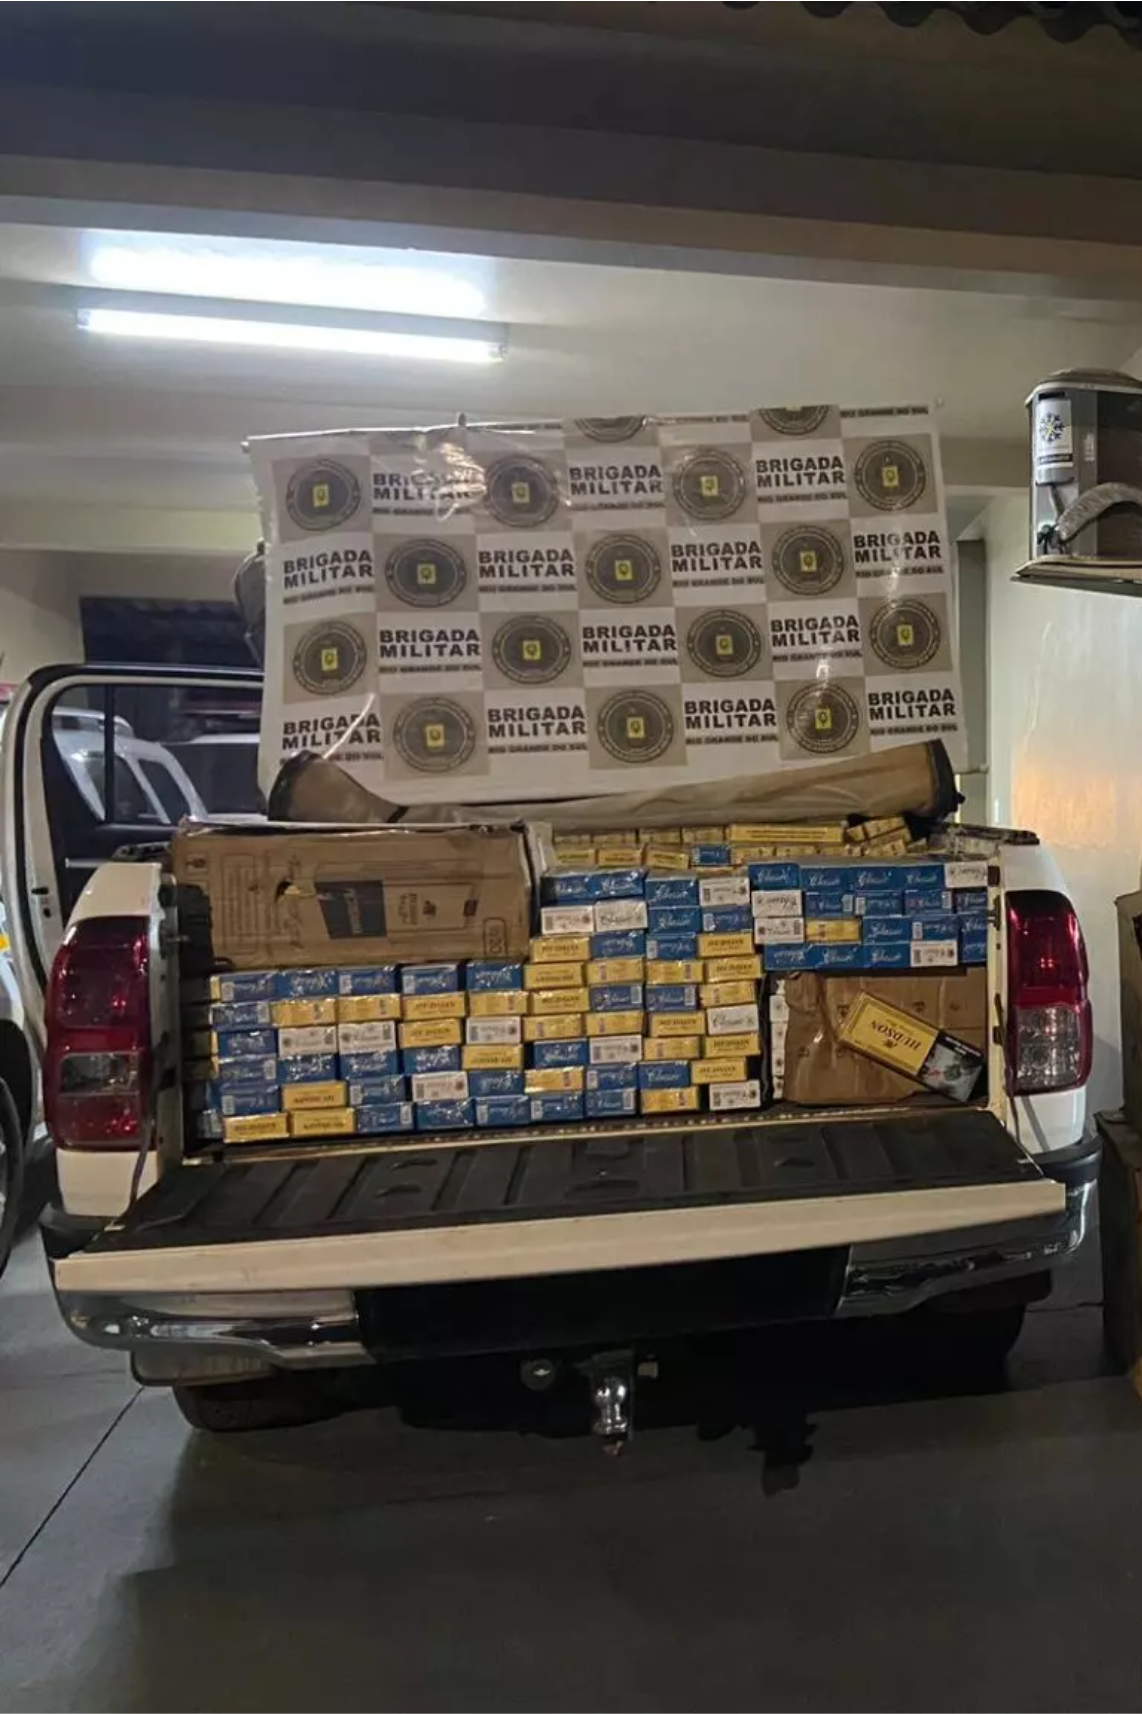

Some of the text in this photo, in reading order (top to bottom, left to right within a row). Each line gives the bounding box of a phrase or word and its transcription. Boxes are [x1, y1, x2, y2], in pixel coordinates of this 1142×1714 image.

[569, 464, 661, 480] BRIGADA
[756, 456, 844, 473] BRIGADA
[571, 479, 663, 495] MILITAR
[757, 471, 846, 488] MILITAR
[854, 530, 941, 549] BRIGADA
[479, 548, 574, 564] BRIGADA
[671, 541, 762, 558] BRIGADA
[284, 549, 372, 574] BRIGADA
[672, 555, 763, 573] MILITAR
[284, 564, 373, 590] MILITAR
[479, 564, 575, 579] MILITAR
[583, 624, 676, 639] BRIGADA
[771, 614, 859, 633] BRIGADA
[379, 629, 480, 643] BRIGADA
[772, 629, 860, 647] MILITAR
[379, 643, 480, 659] MILITAR
[583, 638, 677, 653] MILITAR
[868, 688, 955, 706] BRIGADA
[488, 705, 585, 723] BRIGADA
[684, 698, 775, 715] BRIGADA
[869, 703, 956, 721] MILITAR
[283, 713, 381, 735] BRIGADA
[488, 721, 587, 738] MILITAR
[685, 712, 776, 730] MILITAR
[282, 729, 382, 750] MILITAR
